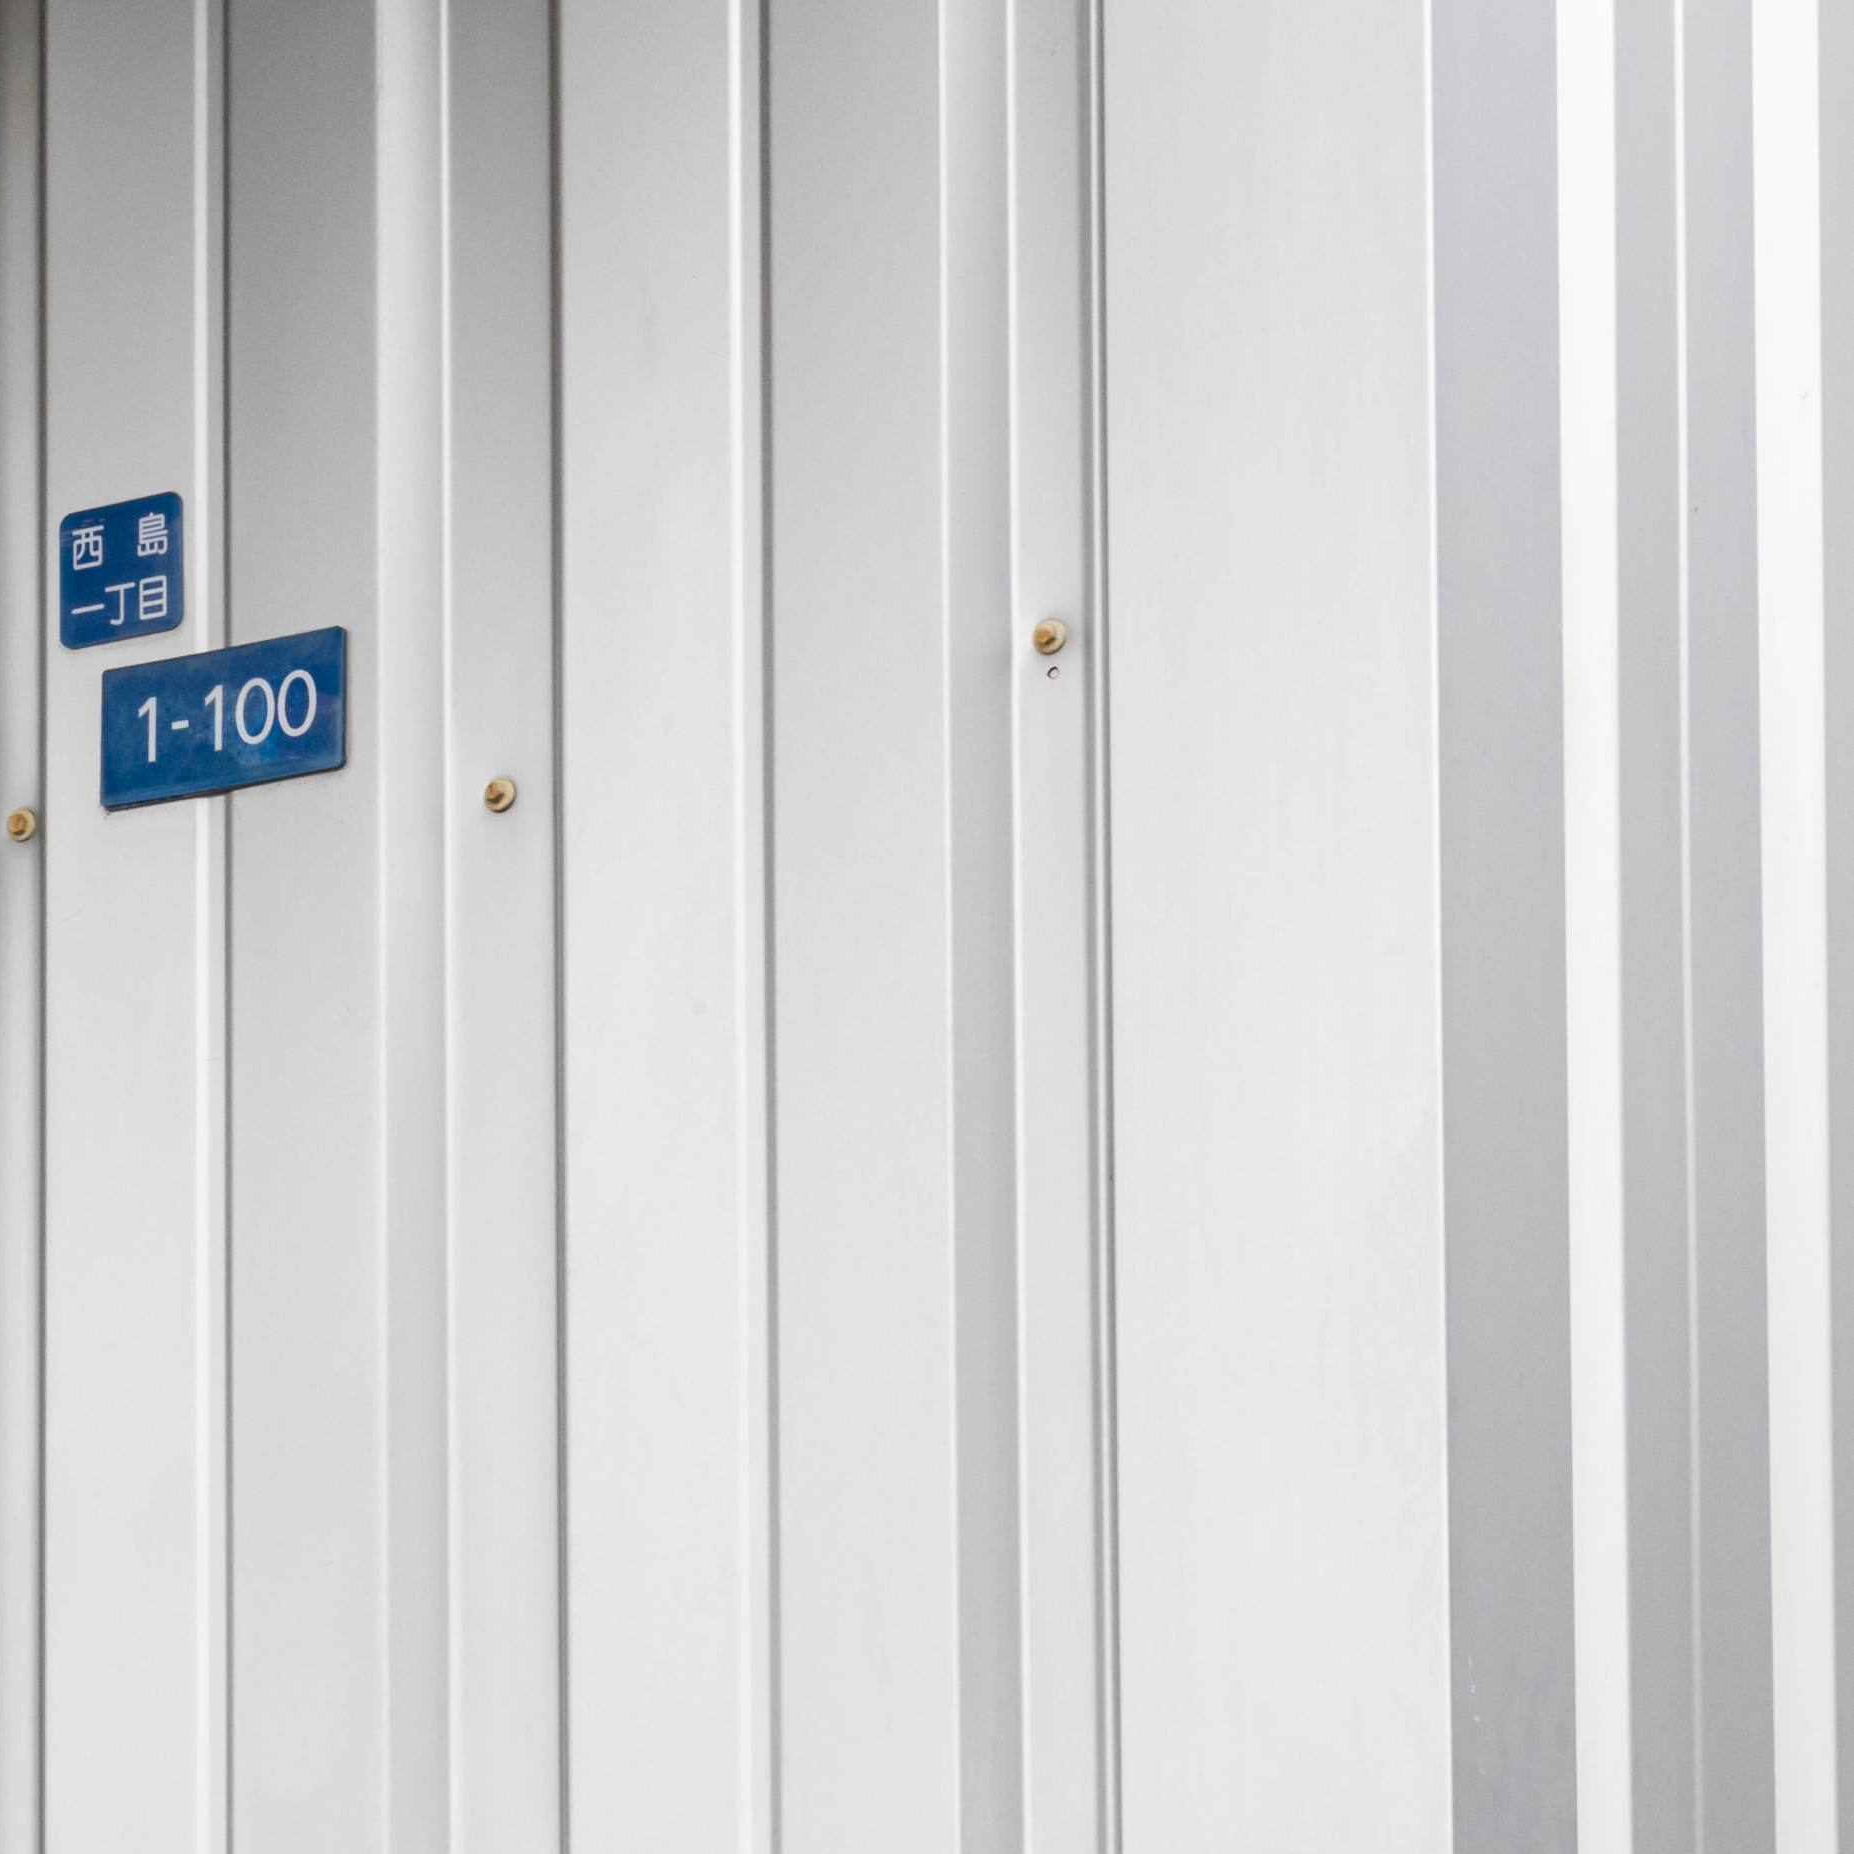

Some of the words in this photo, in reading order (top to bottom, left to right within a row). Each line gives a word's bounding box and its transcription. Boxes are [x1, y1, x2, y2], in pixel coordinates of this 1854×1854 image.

[72, 512, 168, 571] 西島
[71, 575, 168, 625] 一丁目
[137, 669, 318, 763] 1-100
